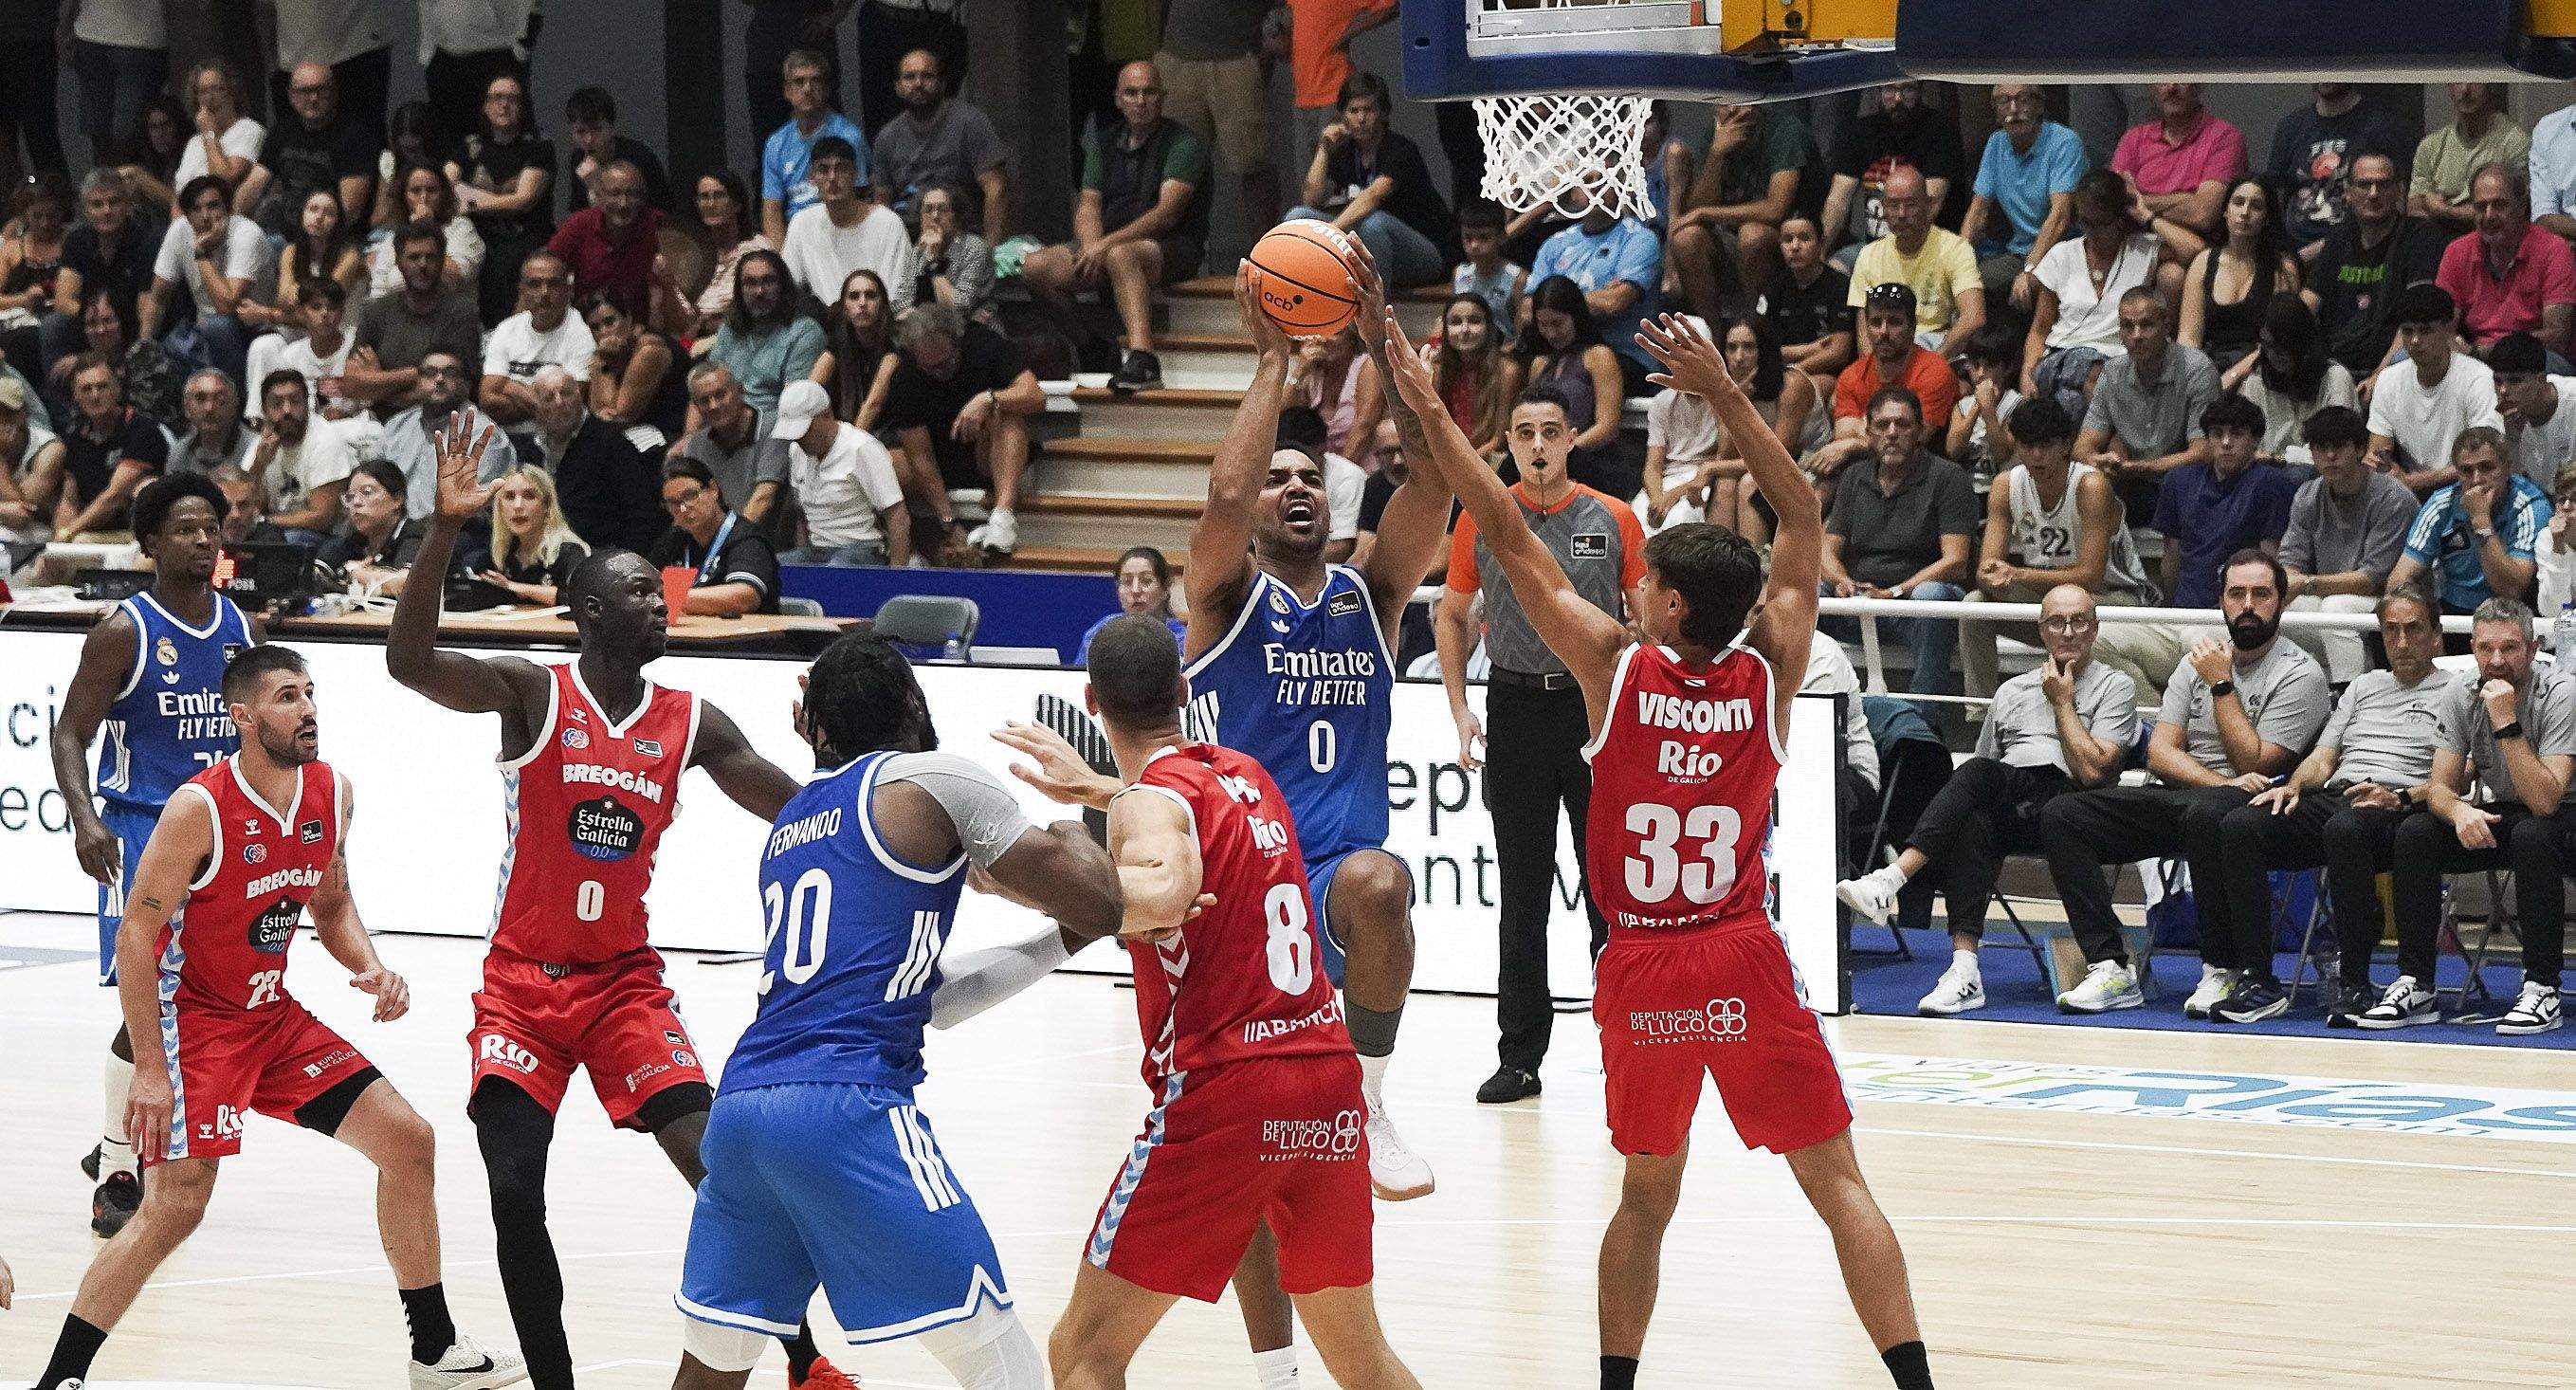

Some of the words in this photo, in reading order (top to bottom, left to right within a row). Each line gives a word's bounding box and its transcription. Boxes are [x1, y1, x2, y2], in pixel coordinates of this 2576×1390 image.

[1264, 291, 1294, 312] acb
[2039, 525, 2072, 557] 22
[1263, 642, 1376, 678] Emirates
[1276, 679, 1307, 705] FLY
[1310, 680, 1366, 706] BETTER
[1638, 690, 1754, 734] VISCONTI
[177, 717, 204, 741] FLY
[1308, 720, 1336, 774] 0
[1657, 740, 1723, 777] Río
[562, 763, 664, 805] BREOGÁN
[1667, 776, 1678, 784] DE
[576, 809, 634, 833] Estrella
[576, 824, 629, 849] Galicia
[767, 806, 842, 861] FERNANDO
[1624, 801, 1742, 905] 33
[246, 863, 324, 900] BREOGÁN
[575, 879, 605, 923] 0
[758, 867, 833, 997] 20
[1264, 882, 1314, 997] 8
[1630, 1008, 1704, 1022] DEPUTACIÓN
[1631, 1019, 1647, 1032] DE
[1648, 1016, 1706, 1035] LUGO
[1633, 1034, 1747, 1046] VICEPRESIDENCIA
[1263, 1119, 1332, 1132] DEPUTACIÓN
[1263, 1129, 1279, 1142] DE
[1280, 1129, 1330, 1150] LUGO
